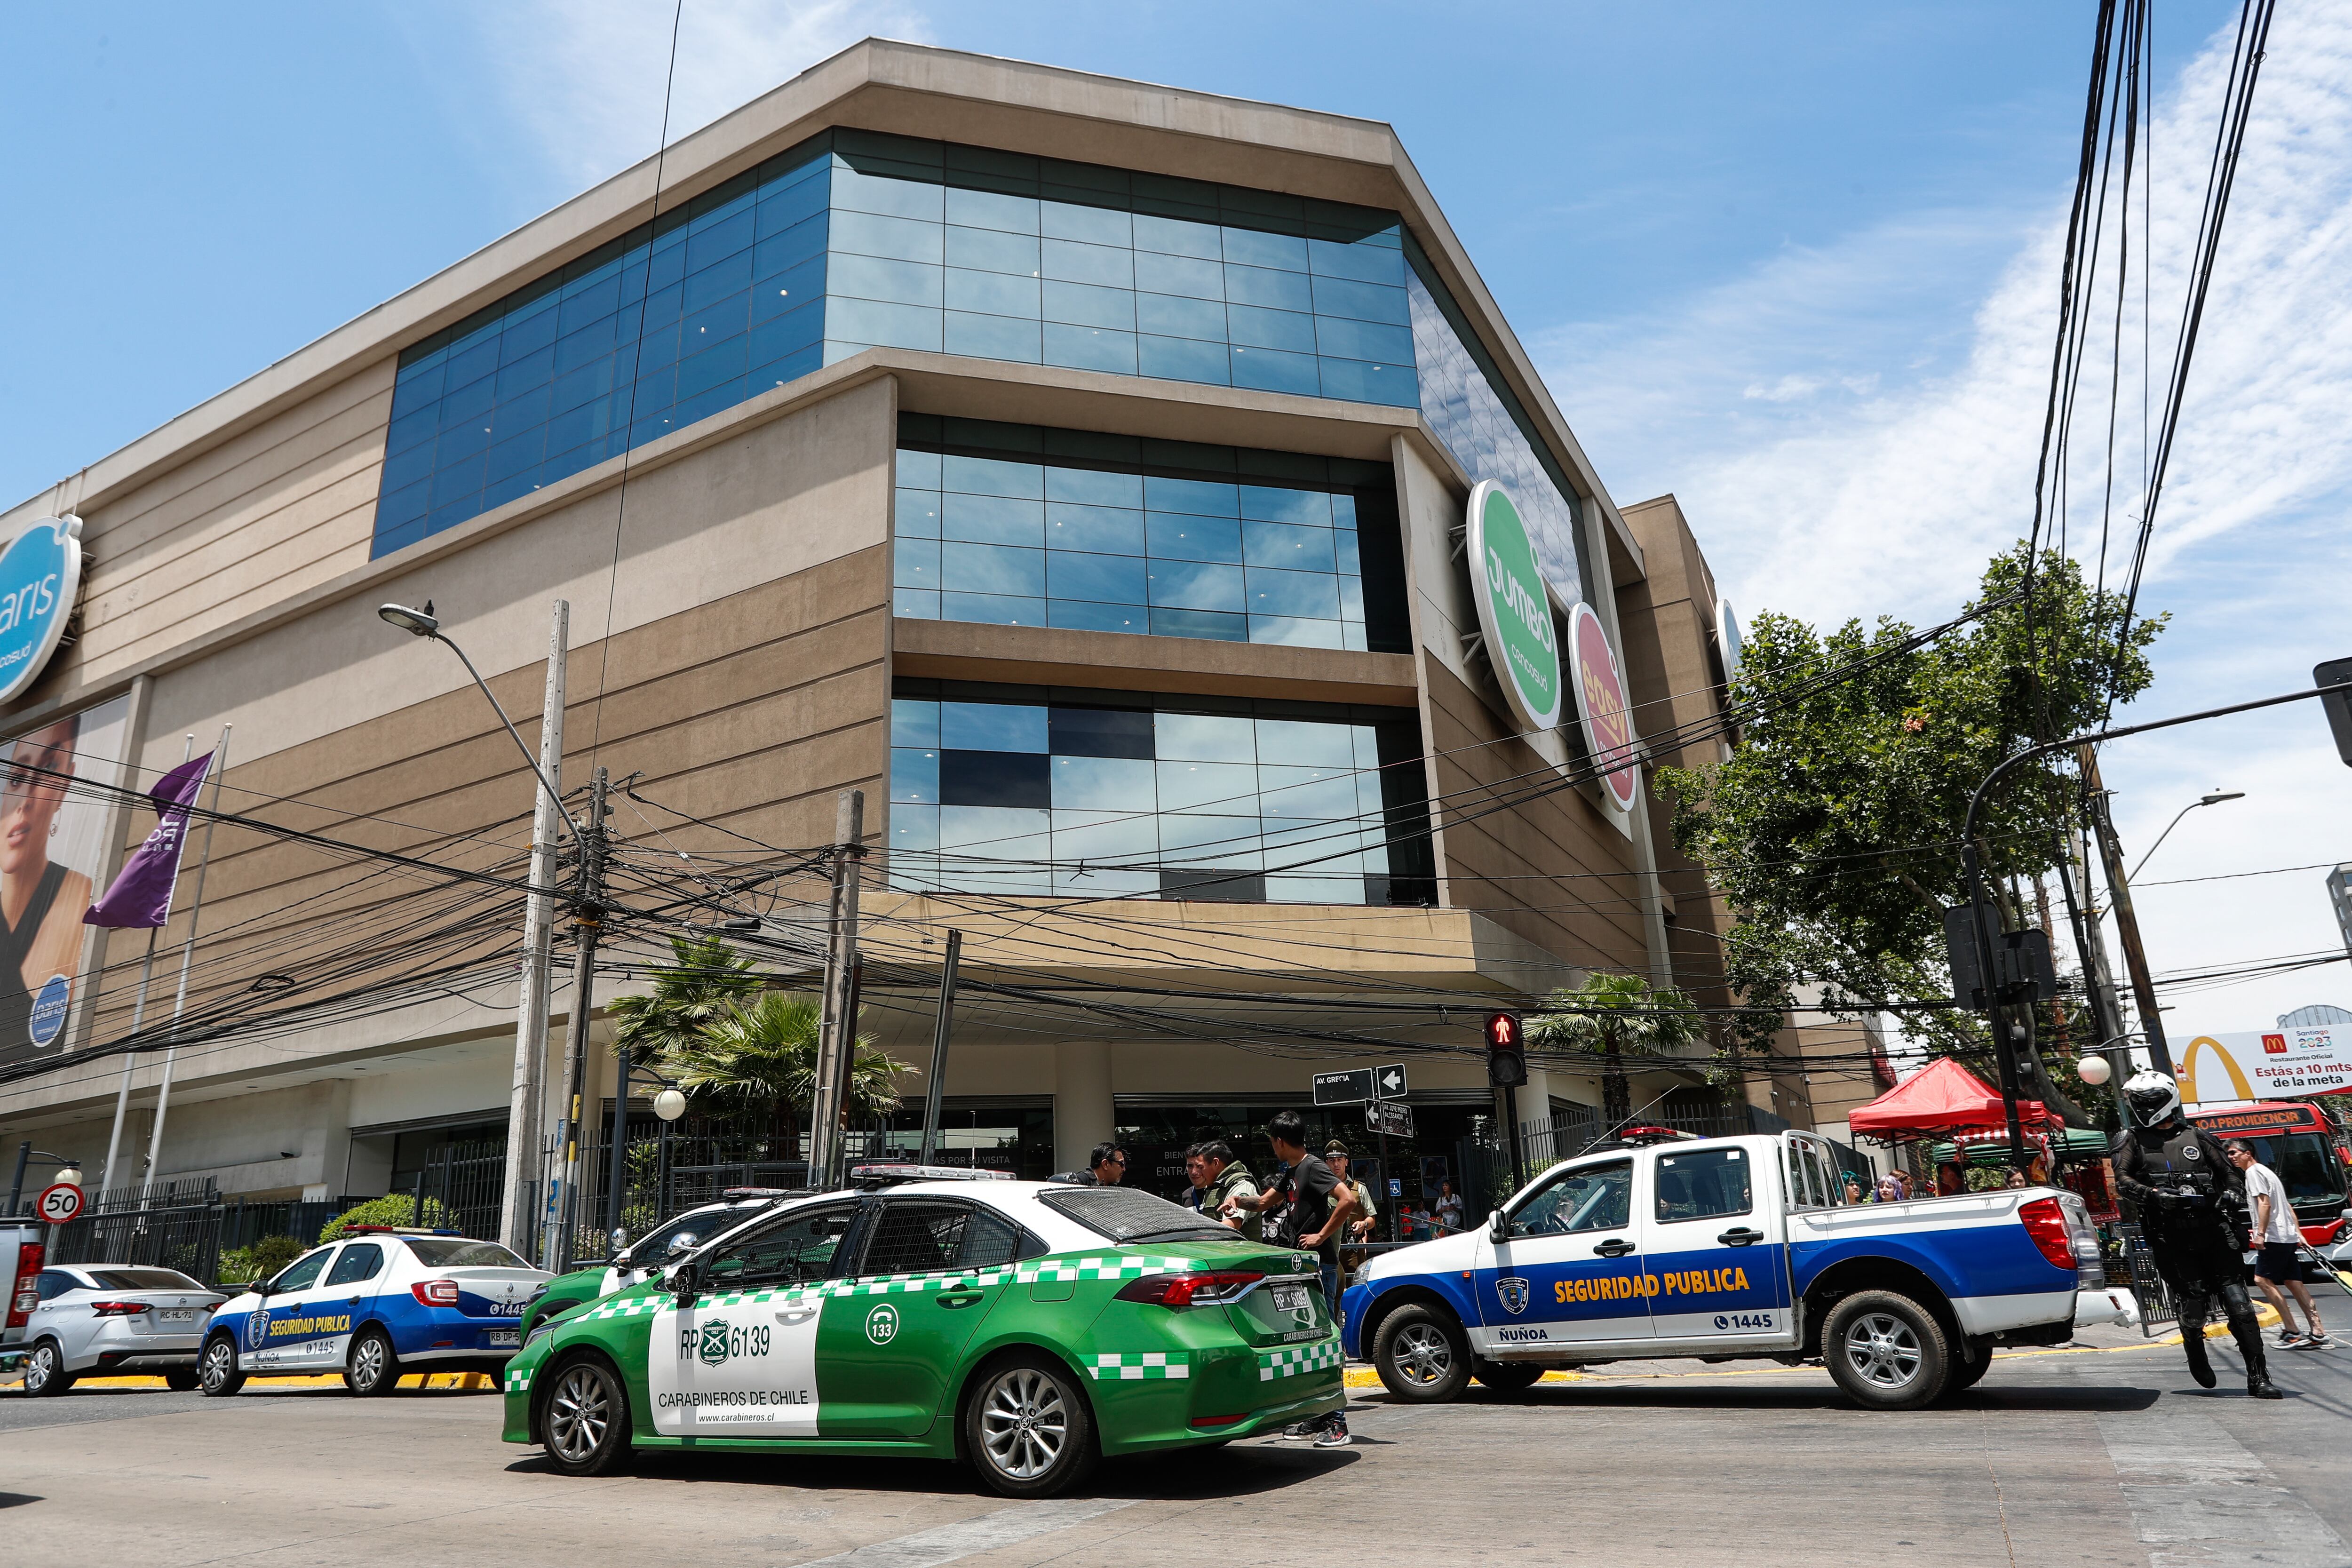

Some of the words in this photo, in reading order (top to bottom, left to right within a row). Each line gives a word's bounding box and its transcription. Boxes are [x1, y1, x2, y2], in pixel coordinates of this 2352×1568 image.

[0, 573, 56, 635] aris
[1489, 546, 1552, 653] JUMBO
[0, 640, 32, 668] cosud
[1511, 644, 1548, 692] cencosud
[1582, 660, 1626, 752] easy
[2298, 1036, 2332, 1049] 2023
[2255, 1066, 2293, 1077] Estás
[2306, 1064, 2321, 1074] 10
[2273, 1078, 2289, 1087] de
[2291, 1077, 2304, 1086] la
[2307, 1075, 2344, 1085] meta
[2217, 1111, 2299, 1128] PROVIDENCIA
[46, 1194, 77, 1213] 50
[1555, 1274, 1660, 1303] SEGURIDAD
[1664, 1267, 1750, 1295] PUBLICA
[1274, 1293, 1285, 1308] RP
[1290, 1291, 1306, 1306] 6139
[270, 1318, 315, 1336] SEGURIDAD
[316, 1314, 350, 1332] PUBLICA
[1731, 1314, 1772, 1328] 1445
[872, 1324, 891, 1337] 133
[1284, 1330, 1309, 1342] CARABINEROS
[1309, 1329, 1314, 1338] DE
[1499, 1327, 1548, 1341] ÑUÑOA
[314, 1341, 334, 1354] 1445
[680, 1329, 699, 1360] RP
[731, 1325, 770, 1358] 6139
[255, 1351, 280, 1362] ÑUÑOA
[659, 1392, 747, 1407] CARABINEROS
[749, 1391, 767, 1406] DE
[770, 1390, 809, 1405] CHILE
[699, 1413, 774, 1422] www.carabineros.cl
